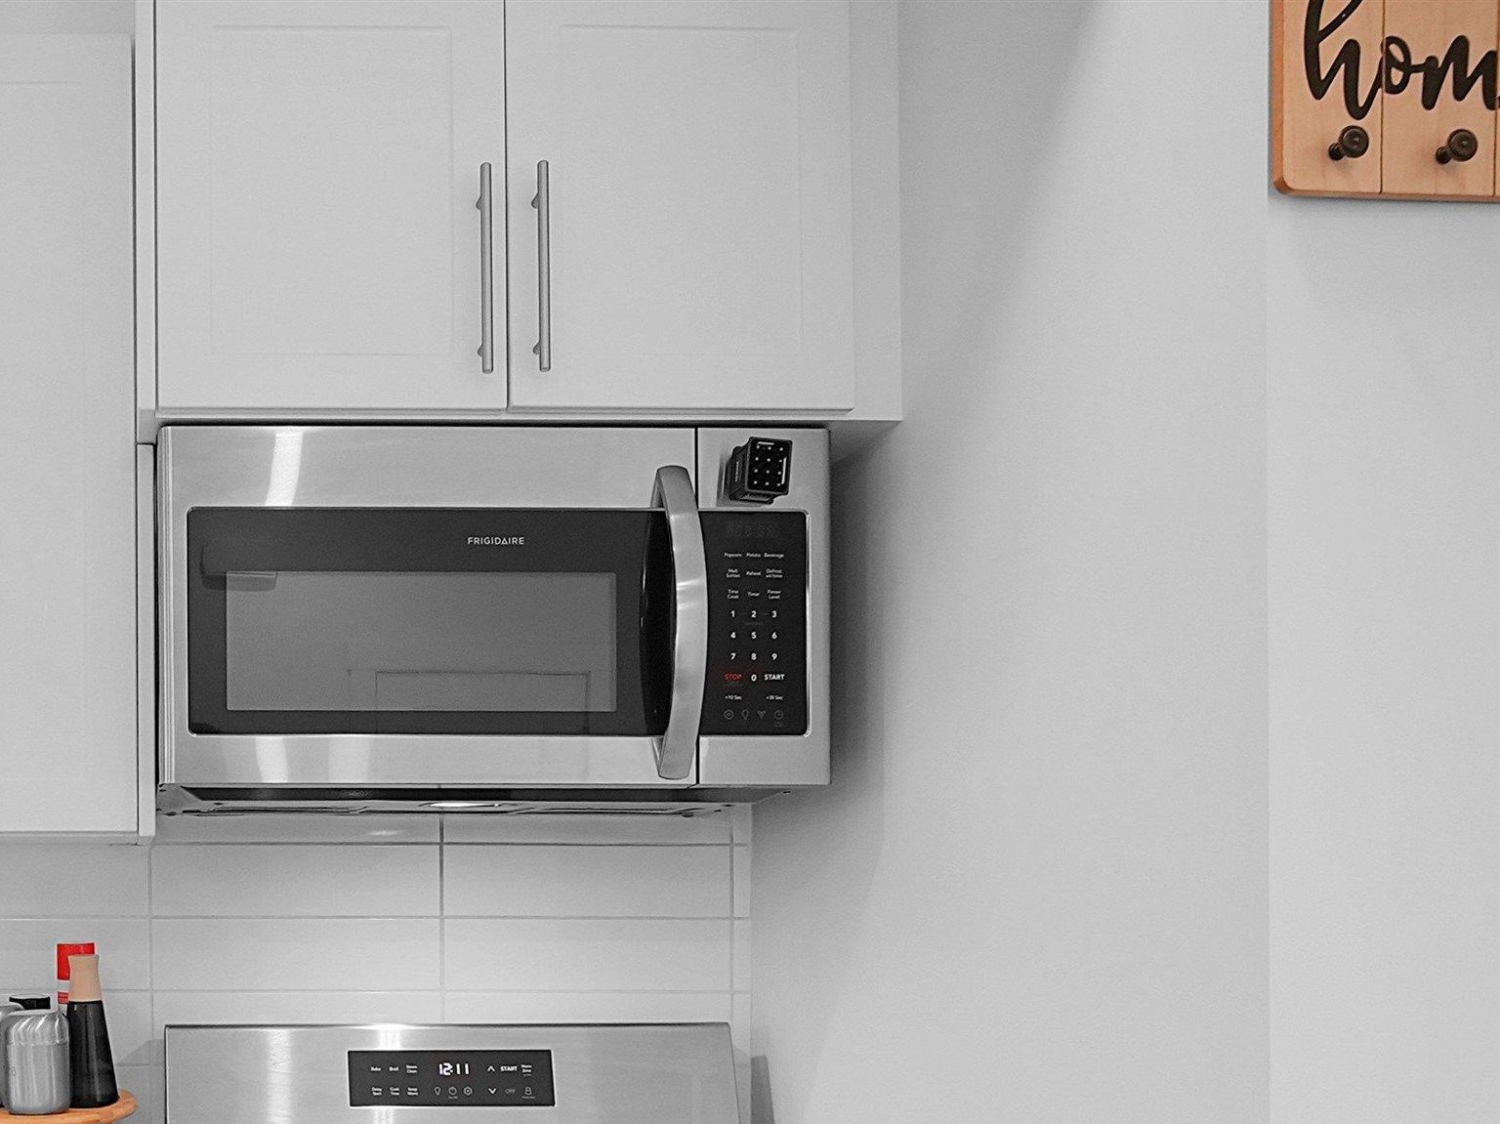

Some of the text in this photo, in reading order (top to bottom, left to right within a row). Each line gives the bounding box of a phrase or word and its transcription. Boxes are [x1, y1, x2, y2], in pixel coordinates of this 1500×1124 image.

[1304, 0, 1500, 120] hom
[467, 536, 525, 545] FRIGIDAIRE
[730, 610, 736, 618] 1
[751, 610, 757, 618] 2
[771, 610, 778, 618] 3
[730, 631, 736, 639] 4
[751, 631, 757, 639] 5
[771, 631, 778, 639] 6
[730, 652, 736, 660] 7
[751, 652, 757, 660] 8
[771, 652, 778, 660] 9
[724, 673, 742, 681] STOP
[750, 673, 757, 682] 0
[764, 673, 785, 681] START
